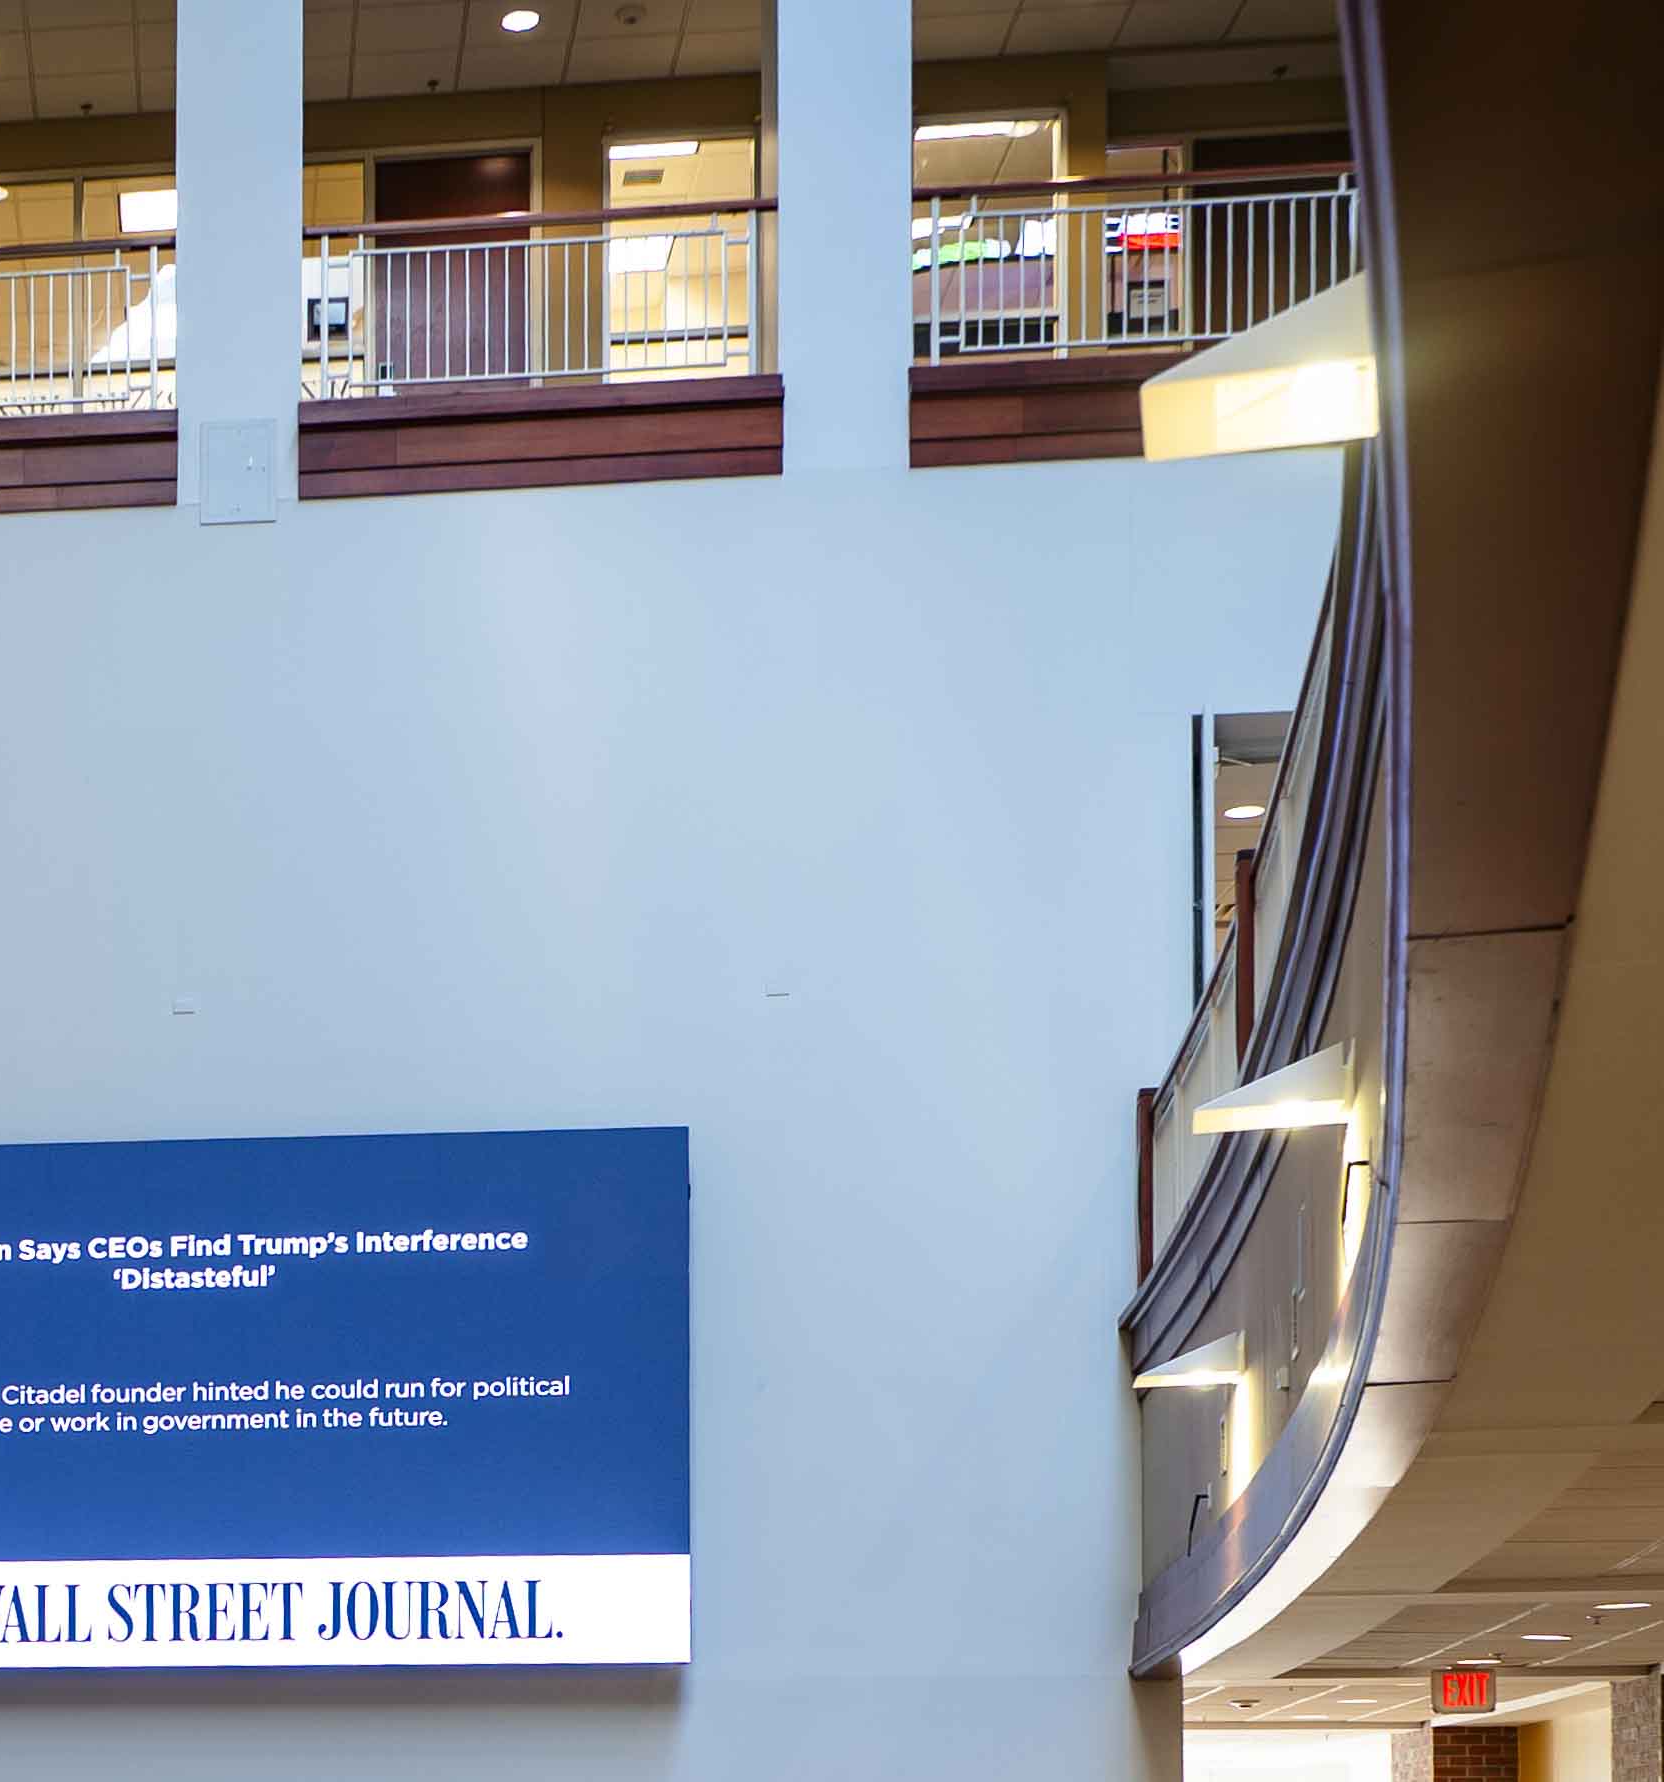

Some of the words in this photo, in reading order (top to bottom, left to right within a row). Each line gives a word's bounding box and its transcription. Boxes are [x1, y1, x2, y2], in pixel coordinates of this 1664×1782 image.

[18, 1239, 81, 1266] Says
[87, 1236, 163, 1260] CEOs
[170, 1233, 231, 1258] Find
[237, 1231, 349, 1259] Trump’s
[356, 1229, 529, 1253] Interference
[1, 1384, 86, 1405] Citadel
[90, 1382, 187, 1404] founder
[192, 1381, 269, 1402] hinted
[275, 1380, 306, 1401] he
[311, 1378, 380, 1400] could
[385, 1382, 425, 1399] run
[430, 1378, 467, 1398] for
[473, 1375, 570, 1401] political
[18, 1416, 44, 1433] or
[50, 1412, 110, 1433] work
[116, 1412, 138, 1431] in
[142, 1409, 290, 1435] government
[295, 1408, 317, 1429] in
[322, 1407, 363, 1428] the
[368, 1406, 449, 1427] future.
[107, 1582, 303, 1642] STREET
[317, 1580, 563, 1641] JOURNAL.
[1442, 1672, 1490, 1706] EXIT
